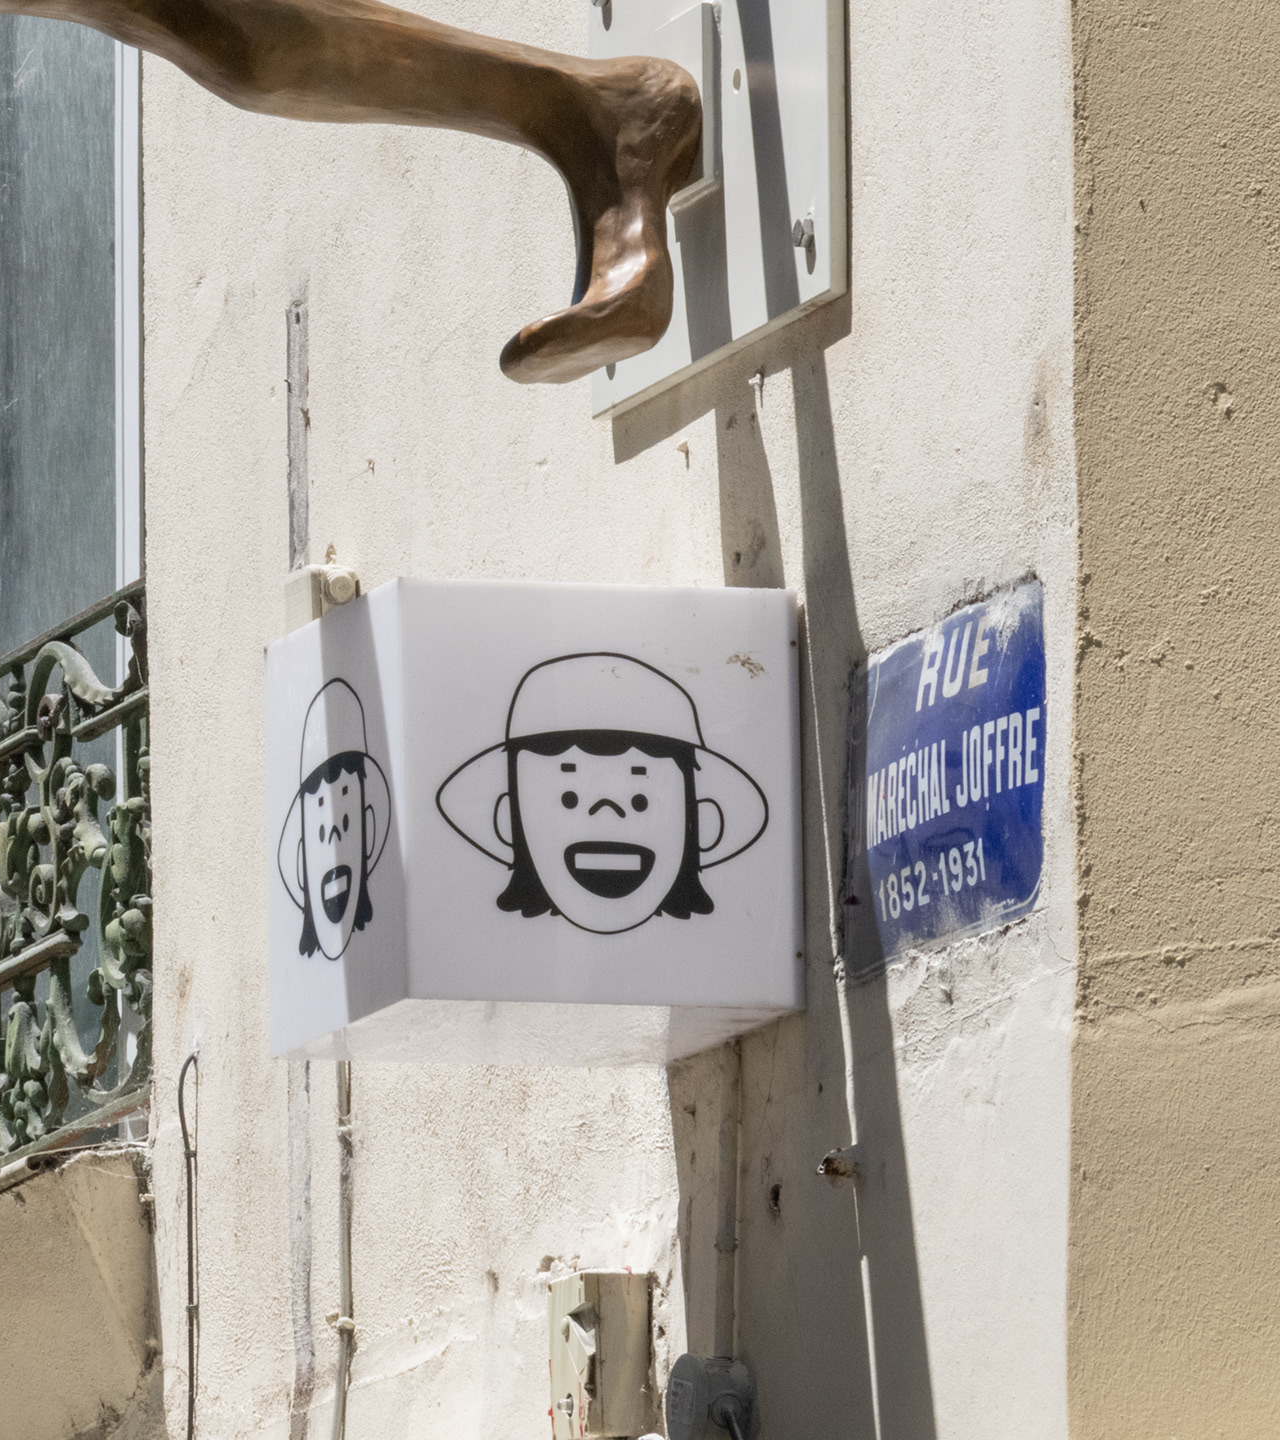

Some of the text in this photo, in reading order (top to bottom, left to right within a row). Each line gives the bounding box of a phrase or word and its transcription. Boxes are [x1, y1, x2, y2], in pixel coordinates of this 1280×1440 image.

[915, 616, 989, 712] RUE
[955, 707, 1040, 808] JOFFRE
[878, 838, 987, 922] 1852-1931
